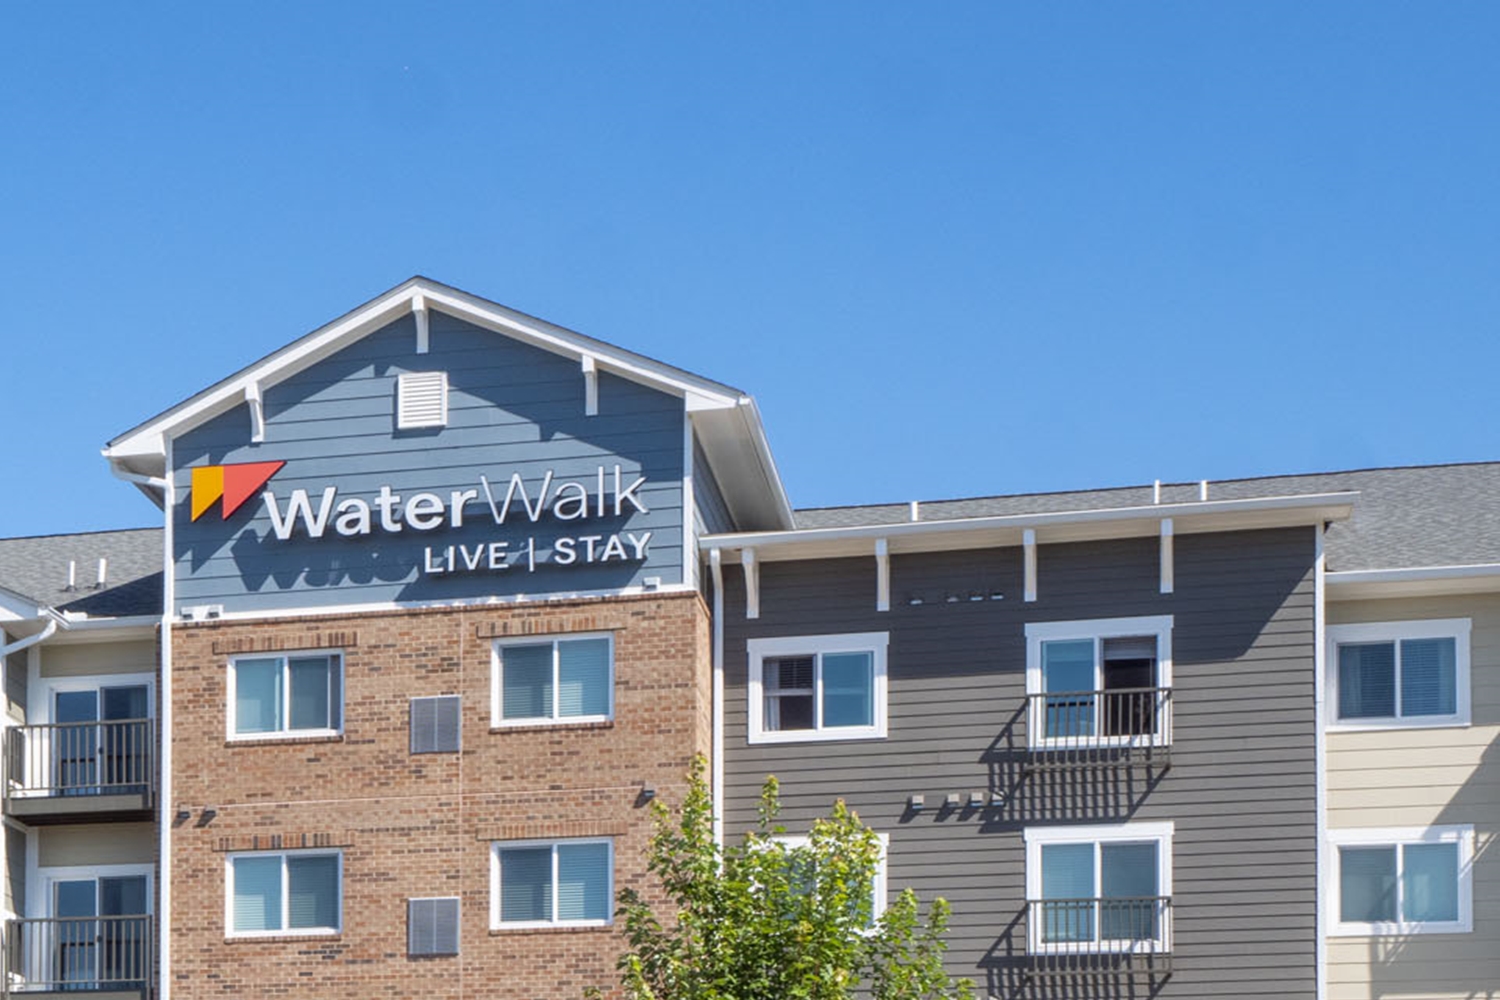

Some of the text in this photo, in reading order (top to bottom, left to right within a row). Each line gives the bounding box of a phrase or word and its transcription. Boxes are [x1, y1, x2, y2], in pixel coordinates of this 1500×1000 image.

[262, 464, 650, 541] WaterWalk
[423, 541, 510, 574] LIVE
[553, 532, 652, 563] STAY
